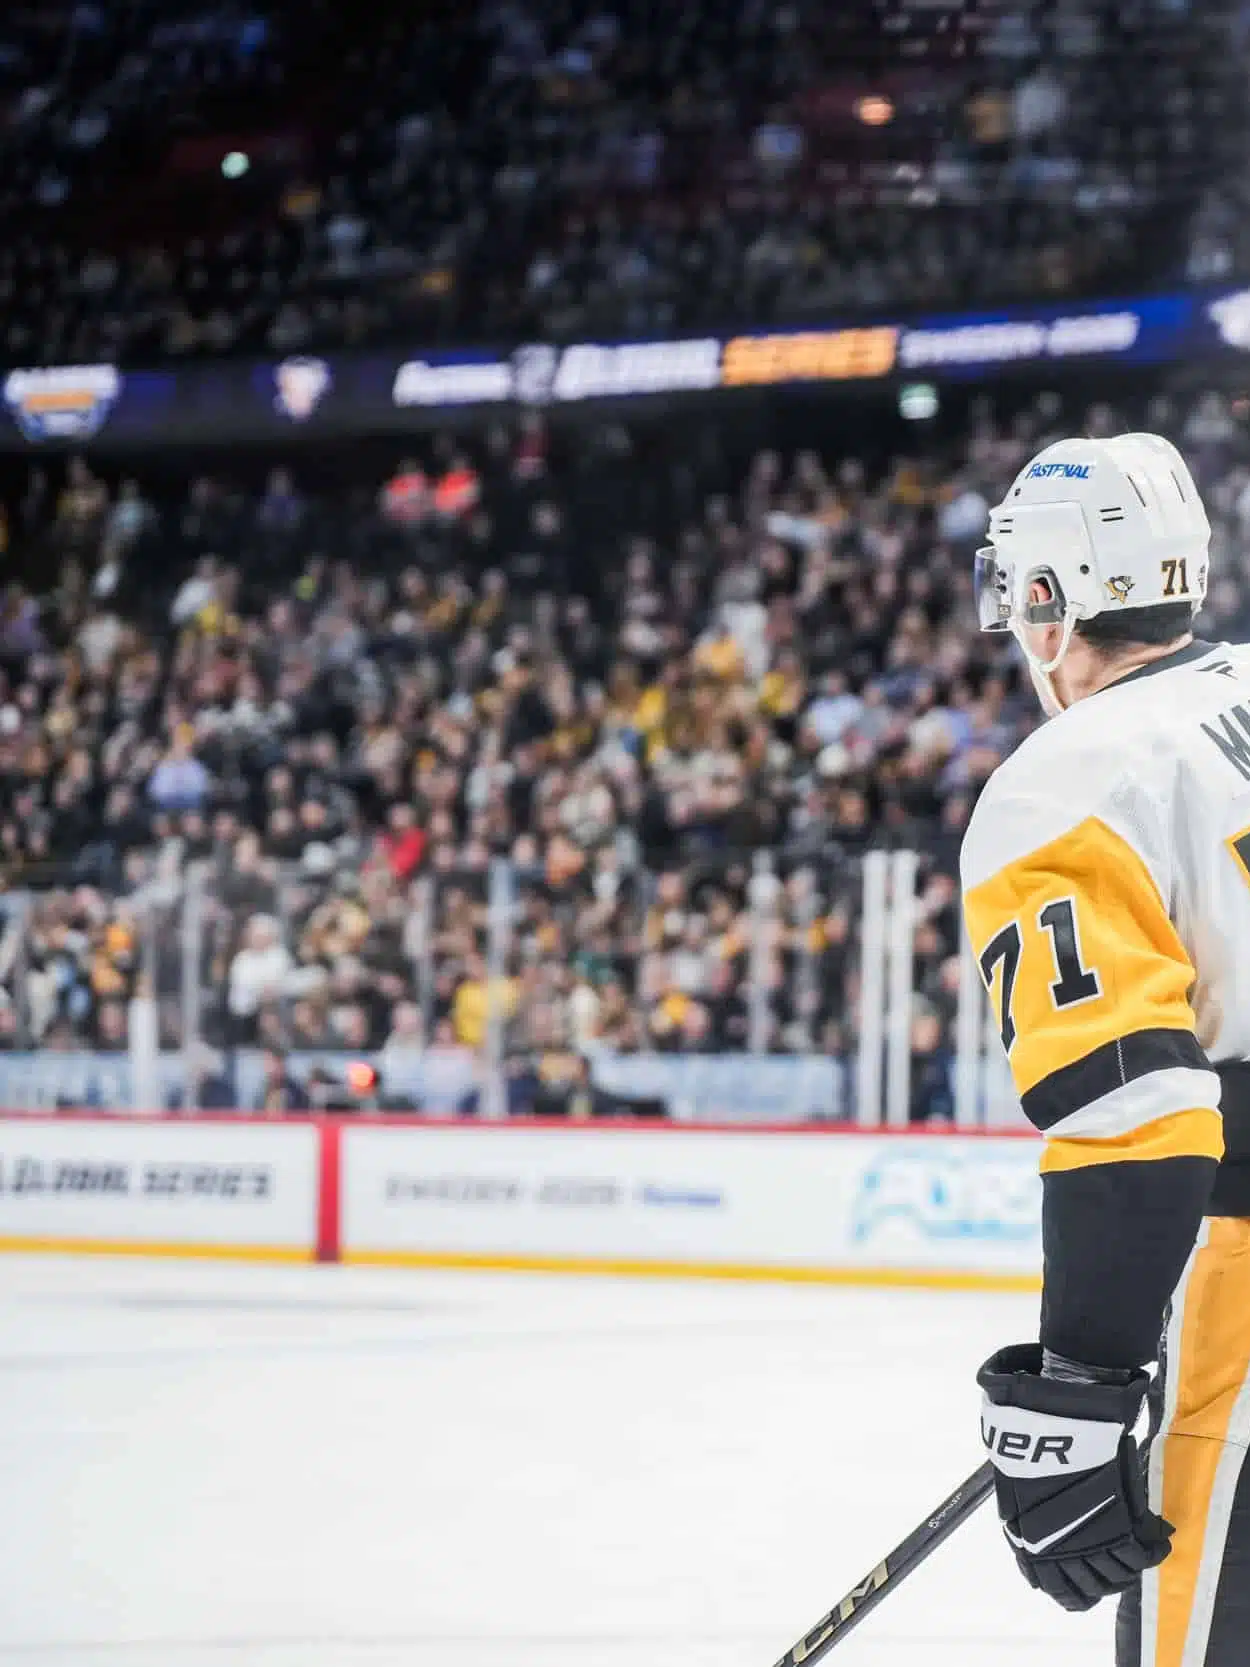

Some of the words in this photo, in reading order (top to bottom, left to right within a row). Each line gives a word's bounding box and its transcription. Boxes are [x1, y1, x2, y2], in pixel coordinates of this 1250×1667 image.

[1025, 463, 1089, 480] FASTENAL
[1161, 557, 1189, 596] 71
[979, 896, 1104, 1059] 71
